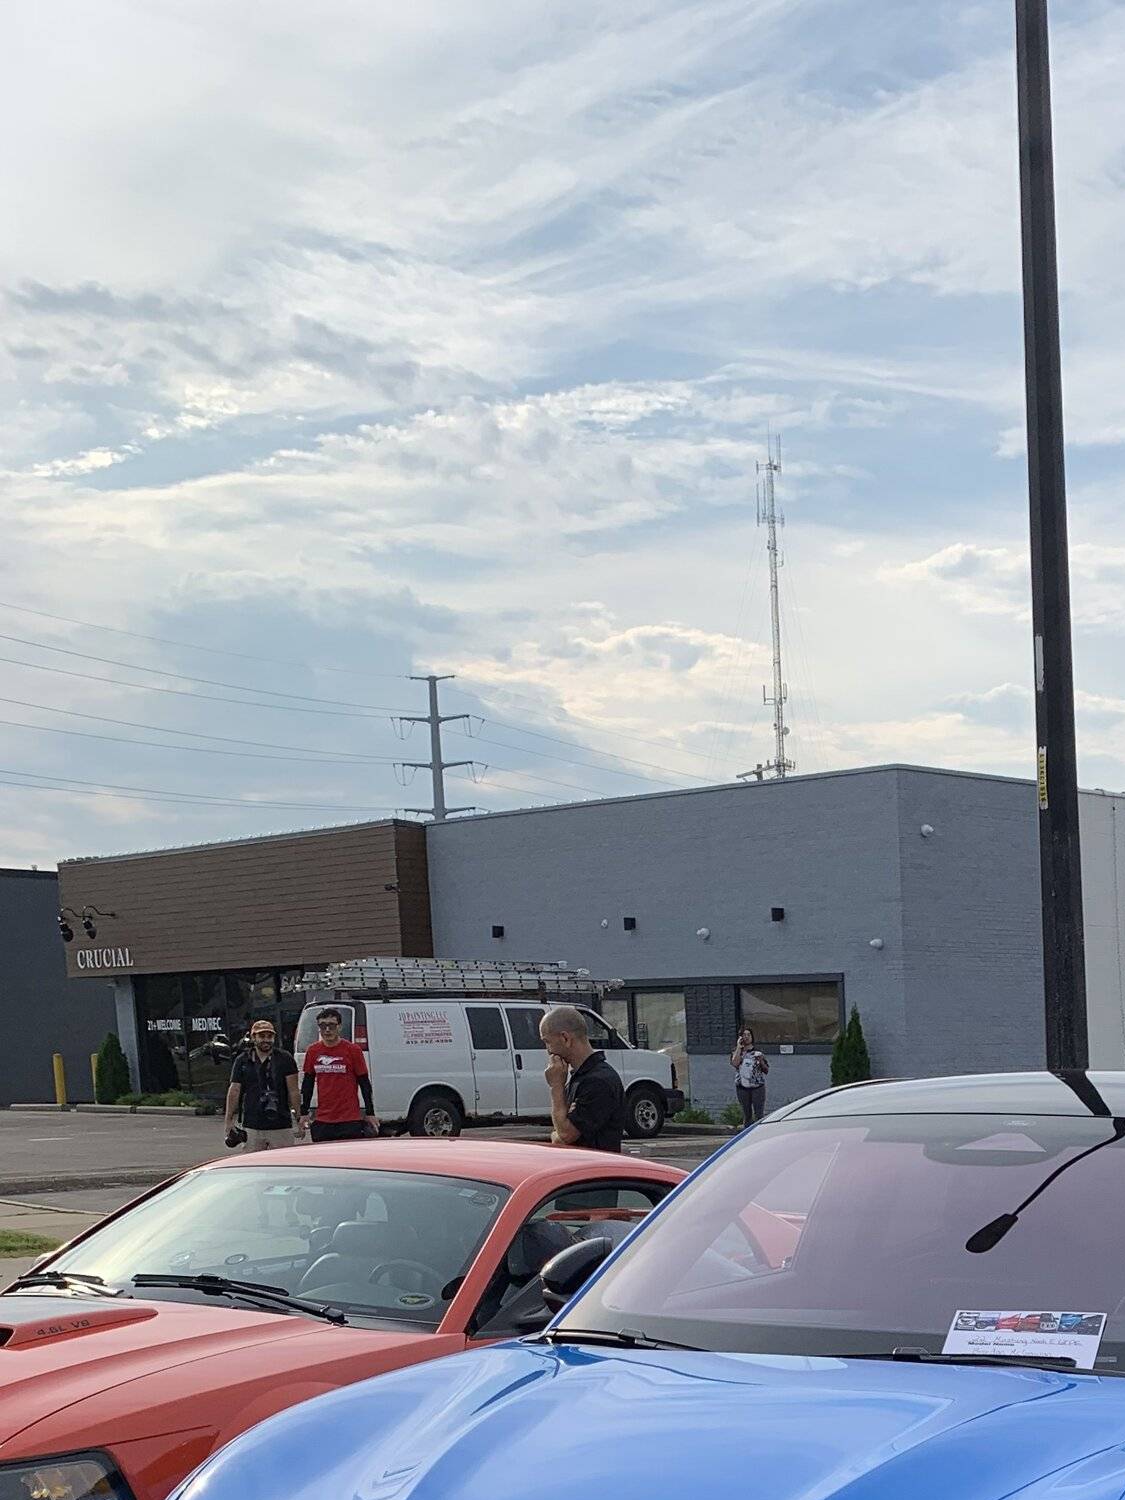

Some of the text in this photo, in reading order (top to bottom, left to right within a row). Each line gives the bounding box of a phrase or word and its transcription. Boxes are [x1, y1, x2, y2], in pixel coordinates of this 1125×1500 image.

[77, 948, 133, 969] CRUCIAL
[192, 1017, 222, 1031] MED/REC
[71, 1319, 90, 1328] V8
